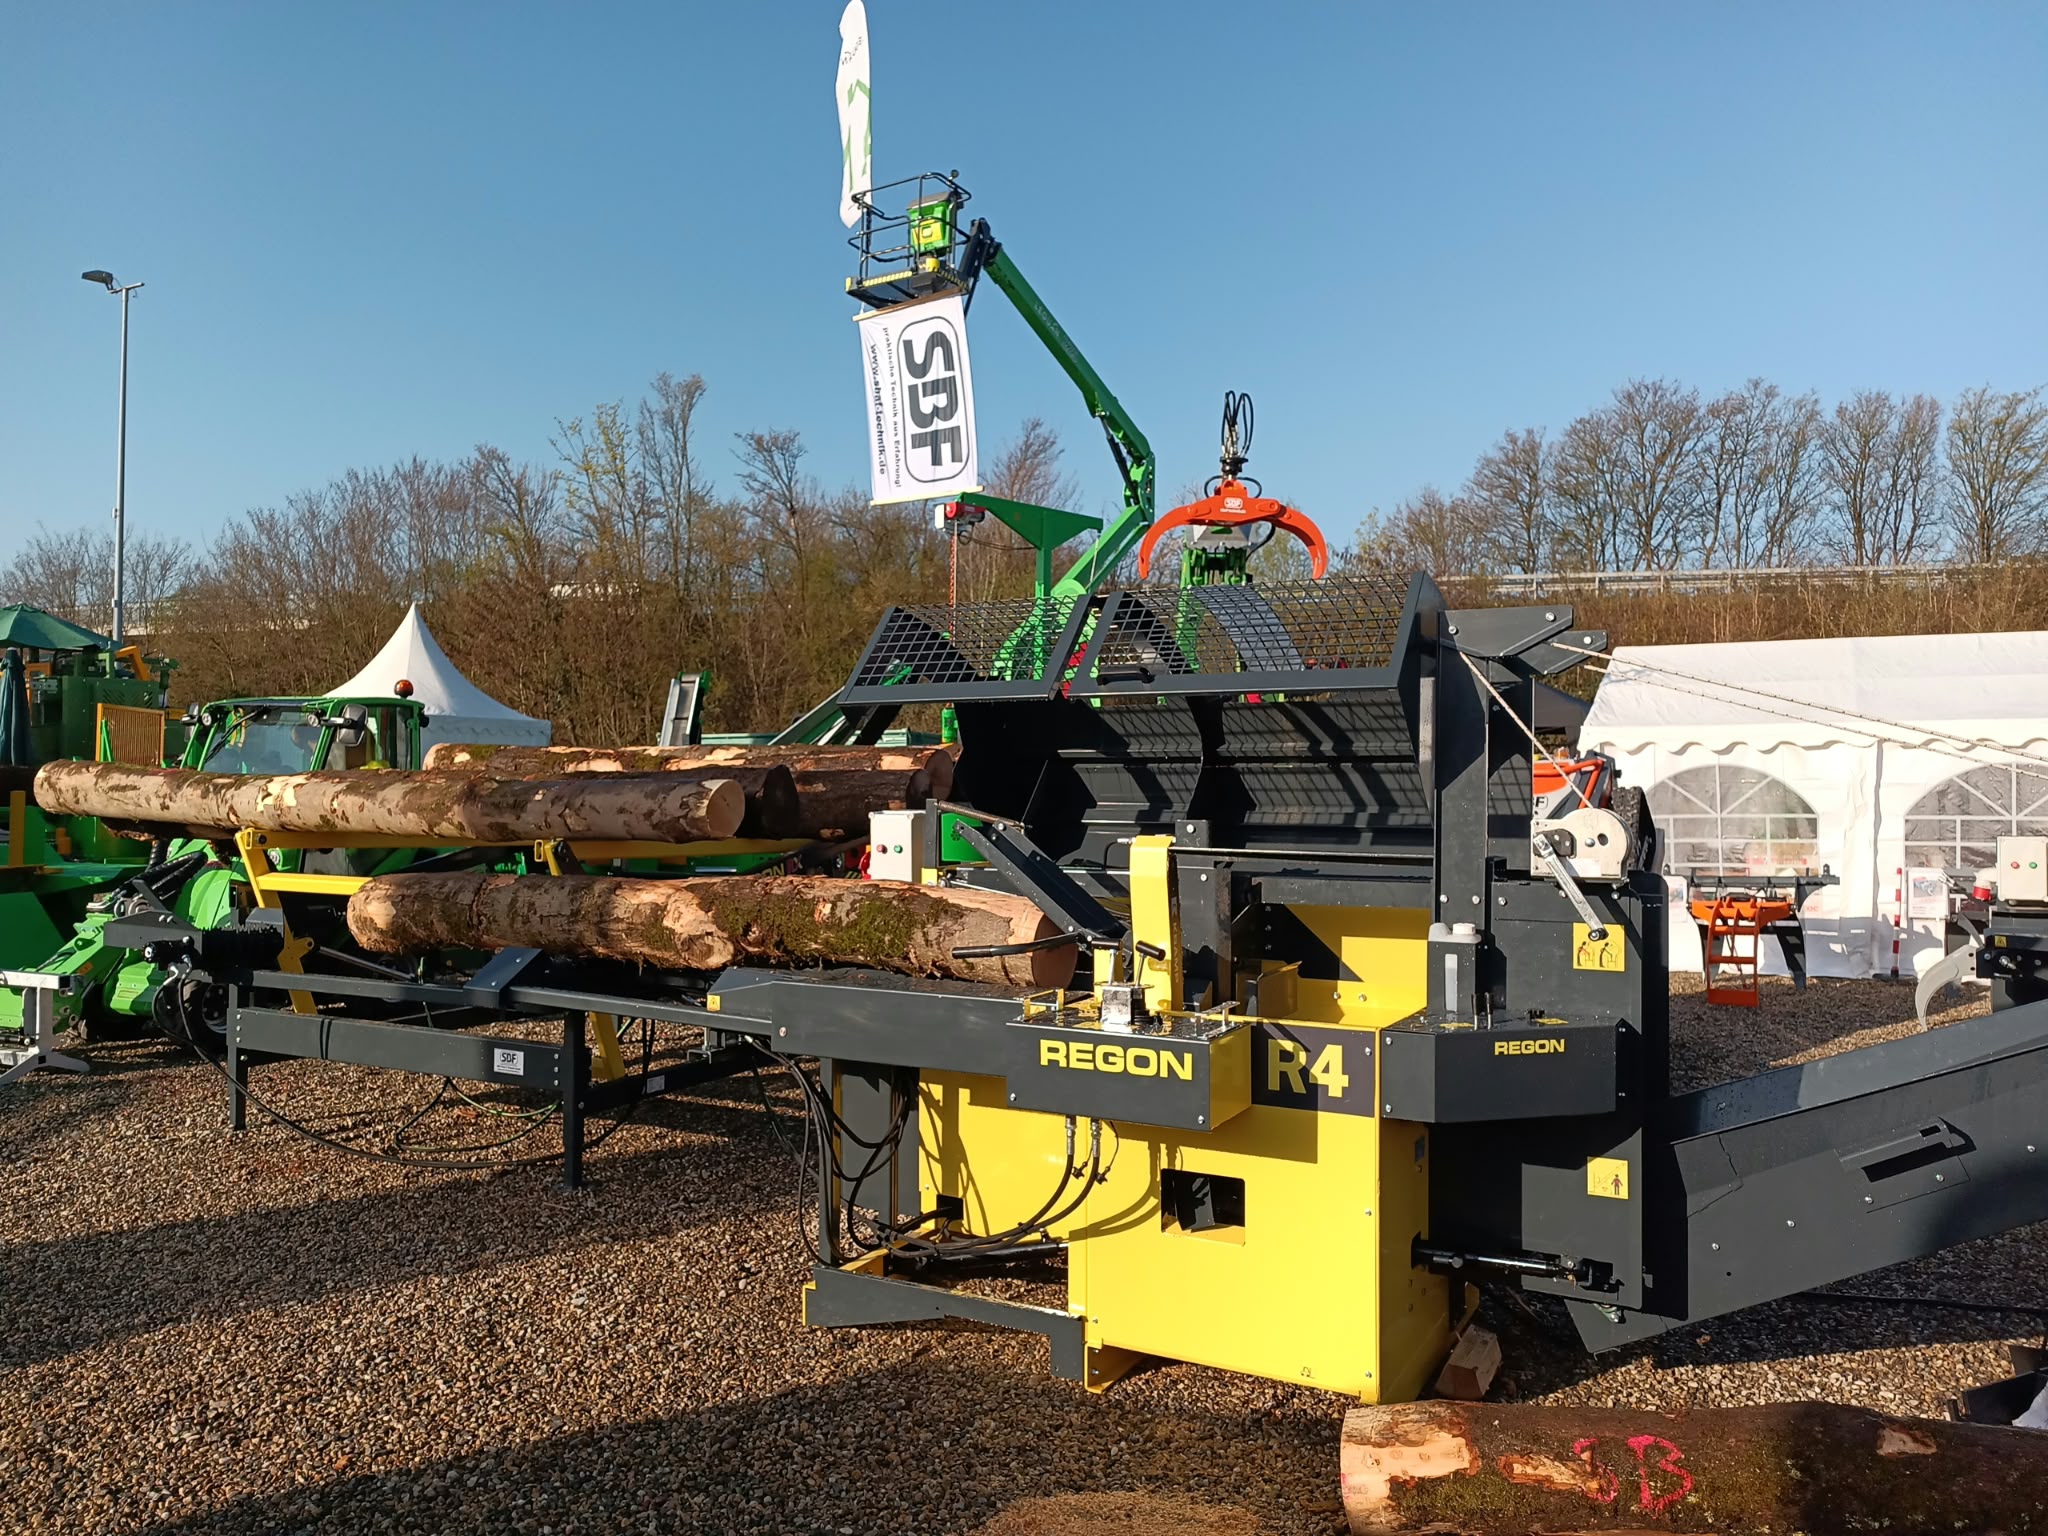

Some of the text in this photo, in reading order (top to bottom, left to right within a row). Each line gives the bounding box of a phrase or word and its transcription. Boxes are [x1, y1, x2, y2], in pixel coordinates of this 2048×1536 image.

[890, 380, 899, 418] Technik
[903, 331, 963, 467] SBF
[1040, 1039, 1192, 1081] REGON
[1268, 1039, 1349, 1098] R4
[1494, 1039, 1565, 1056] REGON
